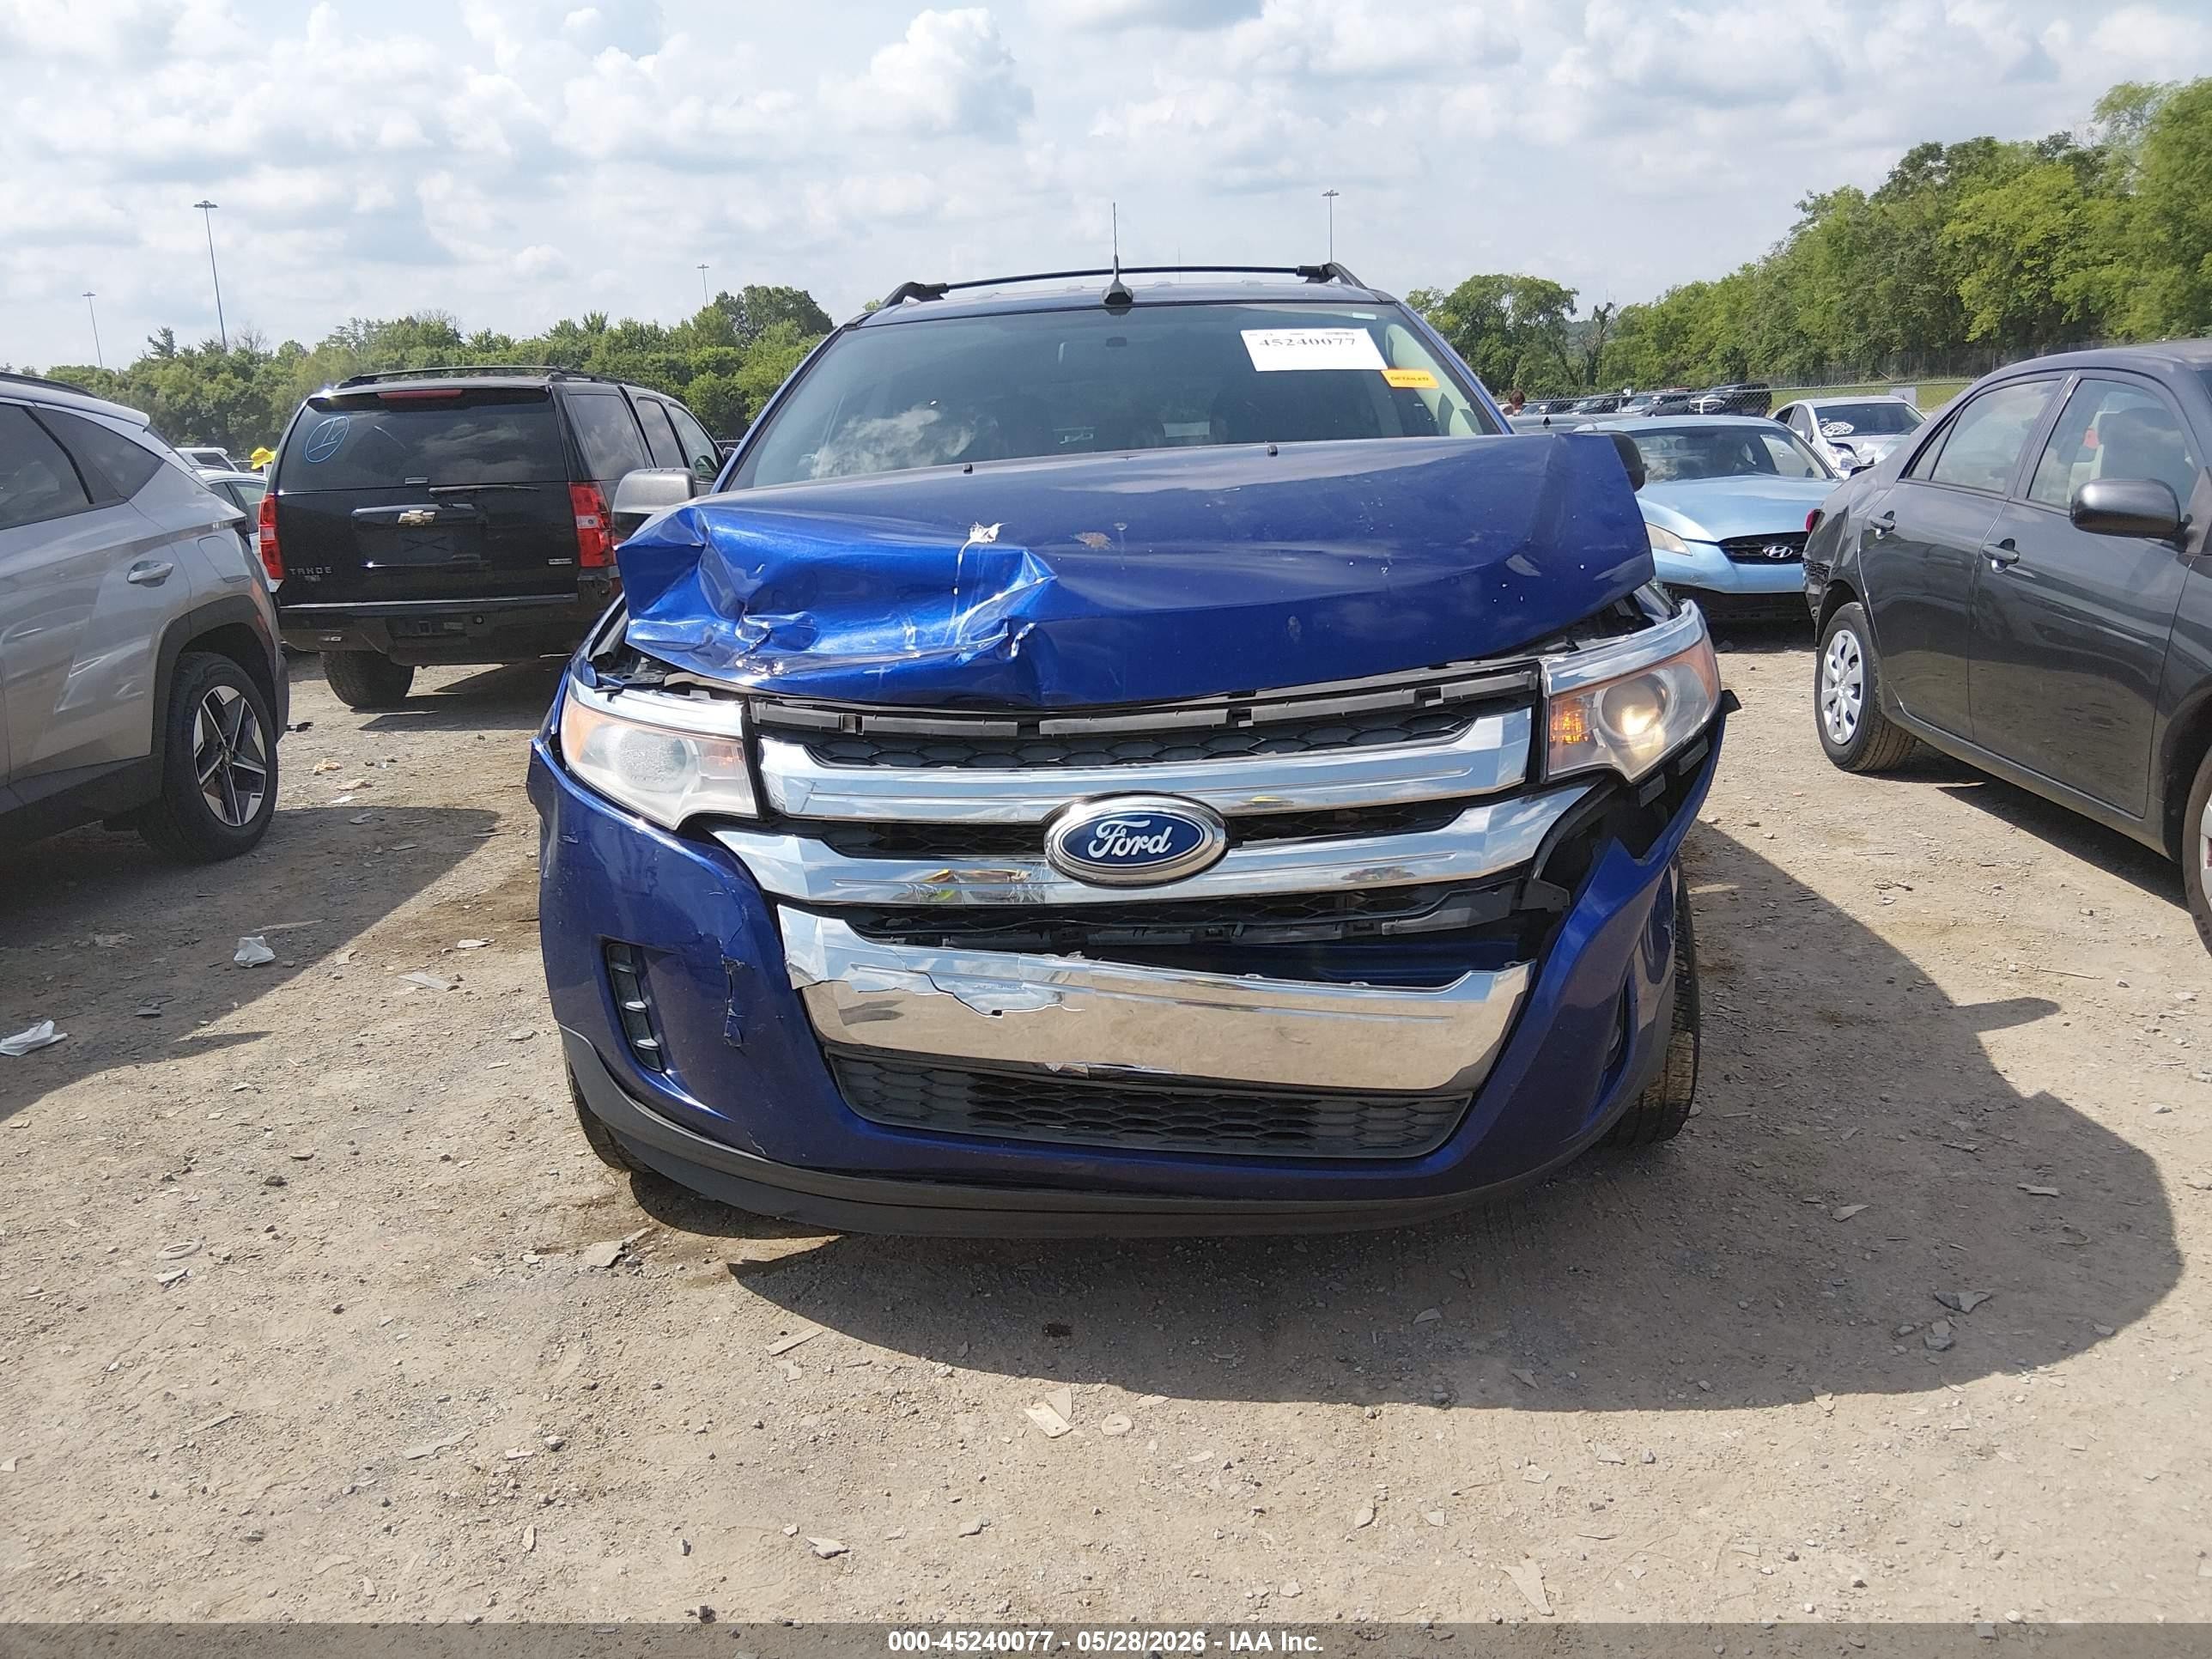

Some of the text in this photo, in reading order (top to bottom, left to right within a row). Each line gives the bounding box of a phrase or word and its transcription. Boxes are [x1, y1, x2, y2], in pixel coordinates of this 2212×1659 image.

[1259, 337, 1355, 346] 45240077
[289, 567, 332, 575] TAHOE
[1087, 819, 1173, 859] Ford
